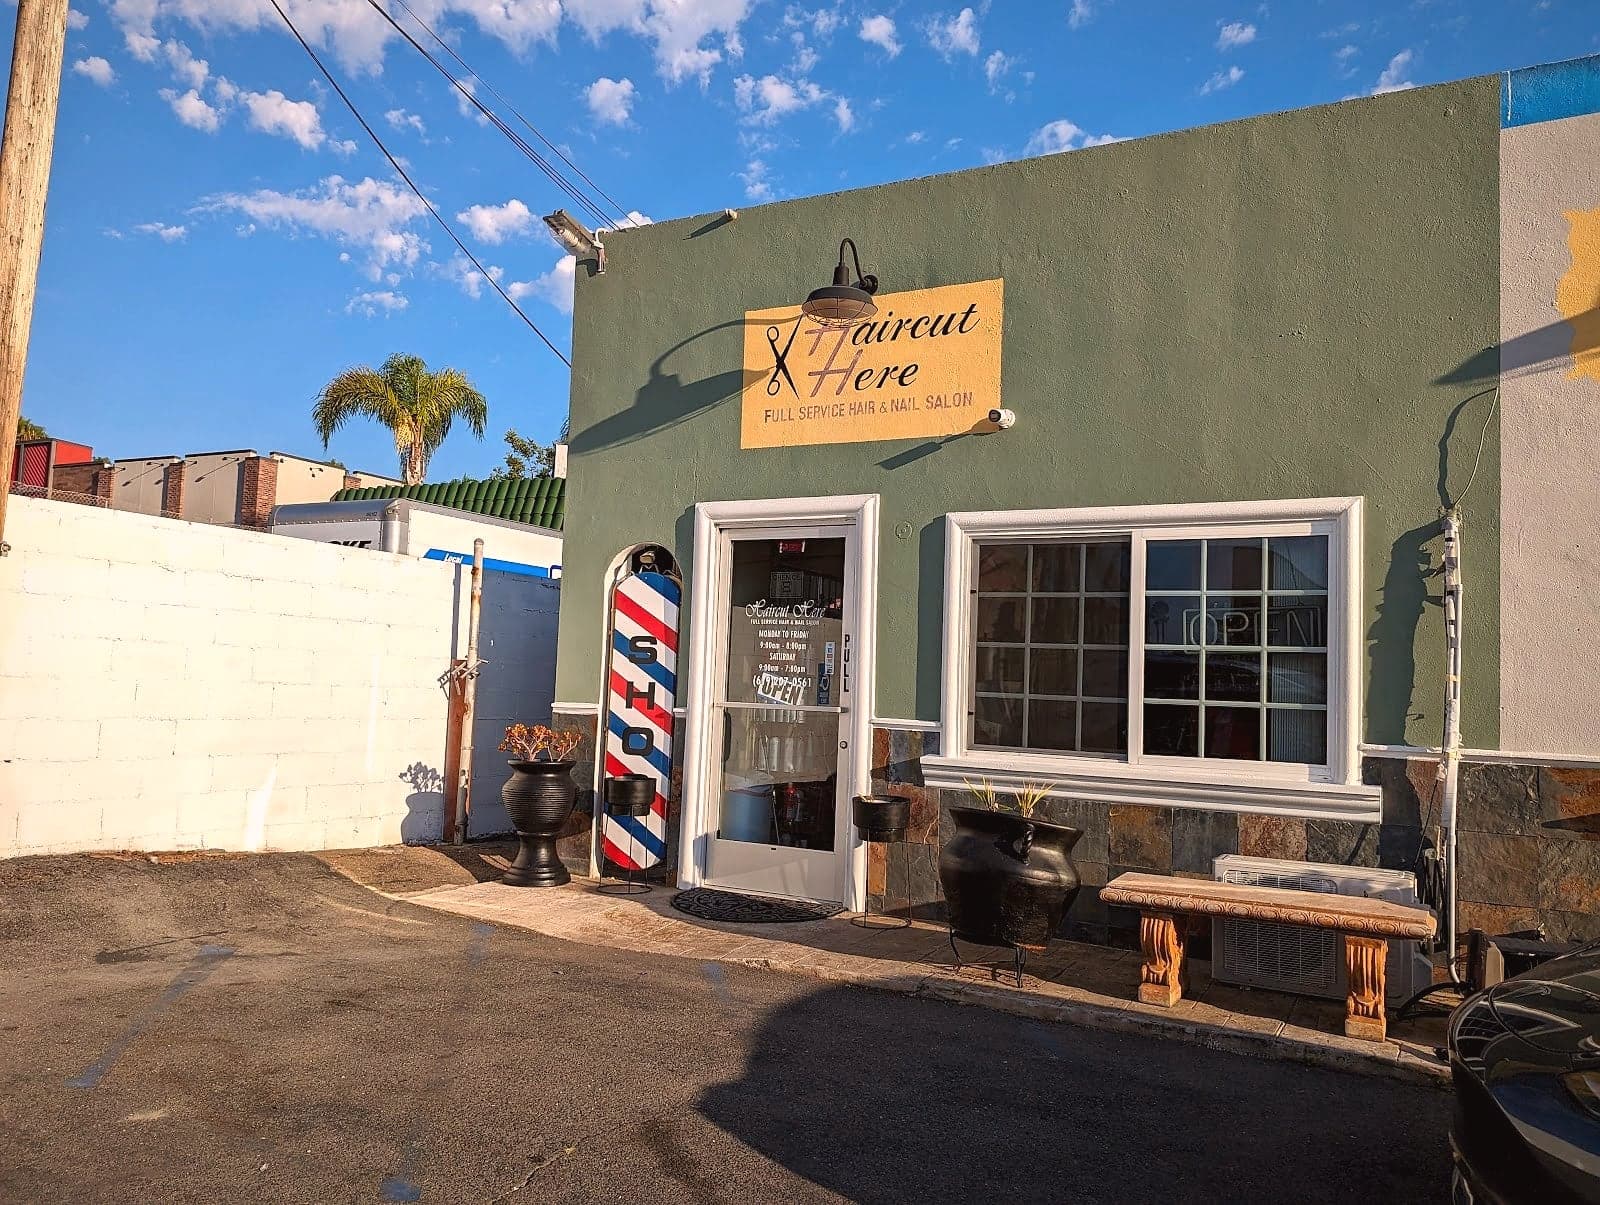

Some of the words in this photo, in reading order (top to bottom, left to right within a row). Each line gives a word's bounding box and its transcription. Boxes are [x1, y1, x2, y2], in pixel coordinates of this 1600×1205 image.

[807, 348, 919, 398] Here
[764, 407, 794, 423] FULL
[798, 403, 844, 420] SERVICE
[848, 400, 876, 416] HAIR
[879, 401, 888, 414] &
[890, 396, 919, 412] NAIL
[925, 391, 973, 410] SALON
[745, 598, 790, 618] Haircut
[792, 599, 826, 618] Here
[758, 629, 781, 638] MONDAY
[782, 630, 789, 638] TO
[790, 630, 809, 639] FRIDAY
[1189, 608, 1314, 648] OPEN
[769, 652, 797, 661] SATURDAY
[843, 633, 851, 693] PULL
[621, 635, 658, 777] SHO
